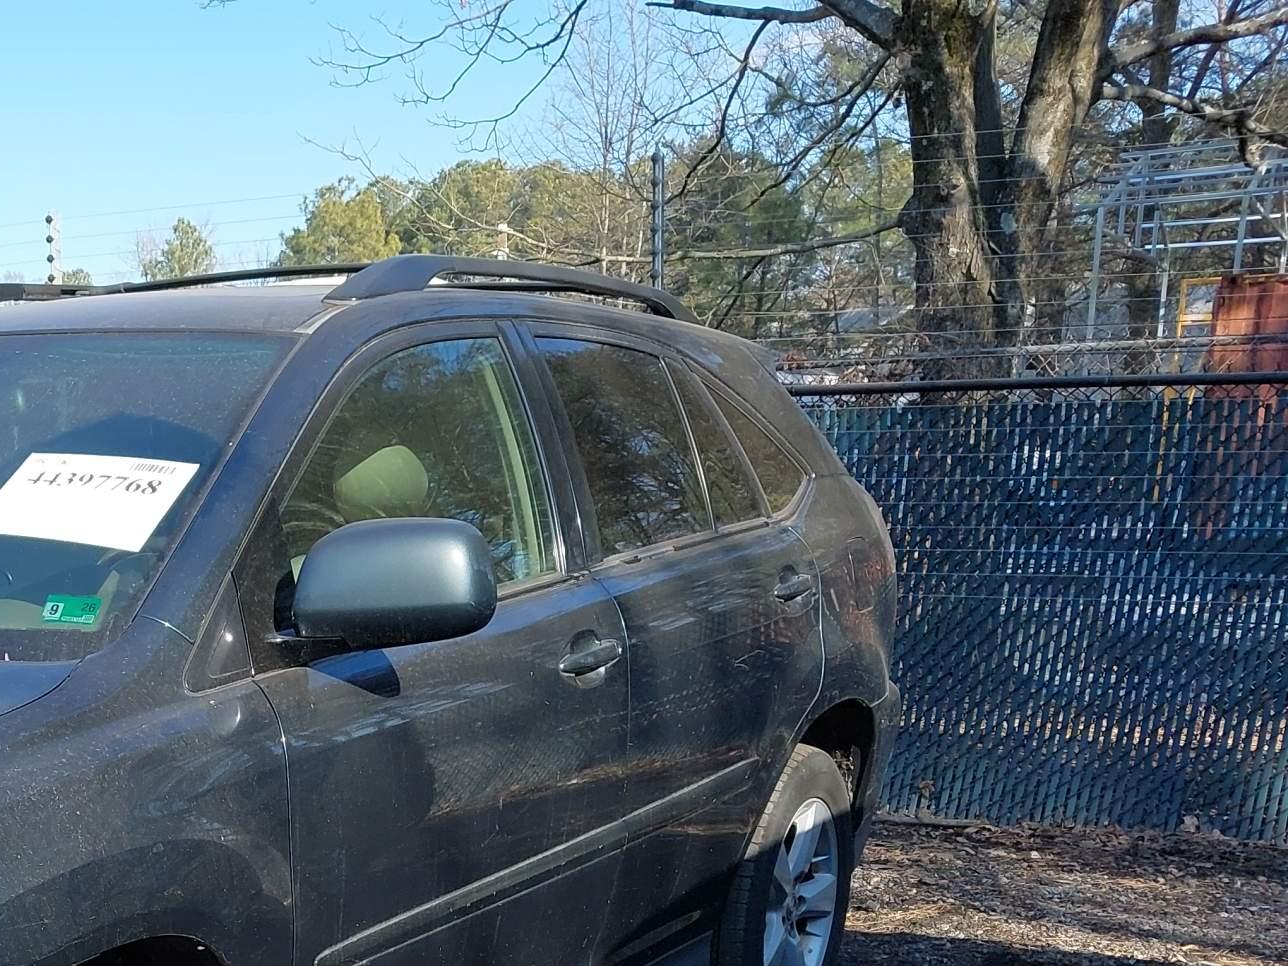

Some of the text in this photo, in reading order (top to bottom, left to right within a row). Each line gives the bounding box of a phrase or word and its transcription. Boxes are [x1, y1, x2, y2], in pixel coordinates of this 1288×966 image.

[28, 471, 162, 495] 44397768
[48, 602, 97, 616] 9 26
